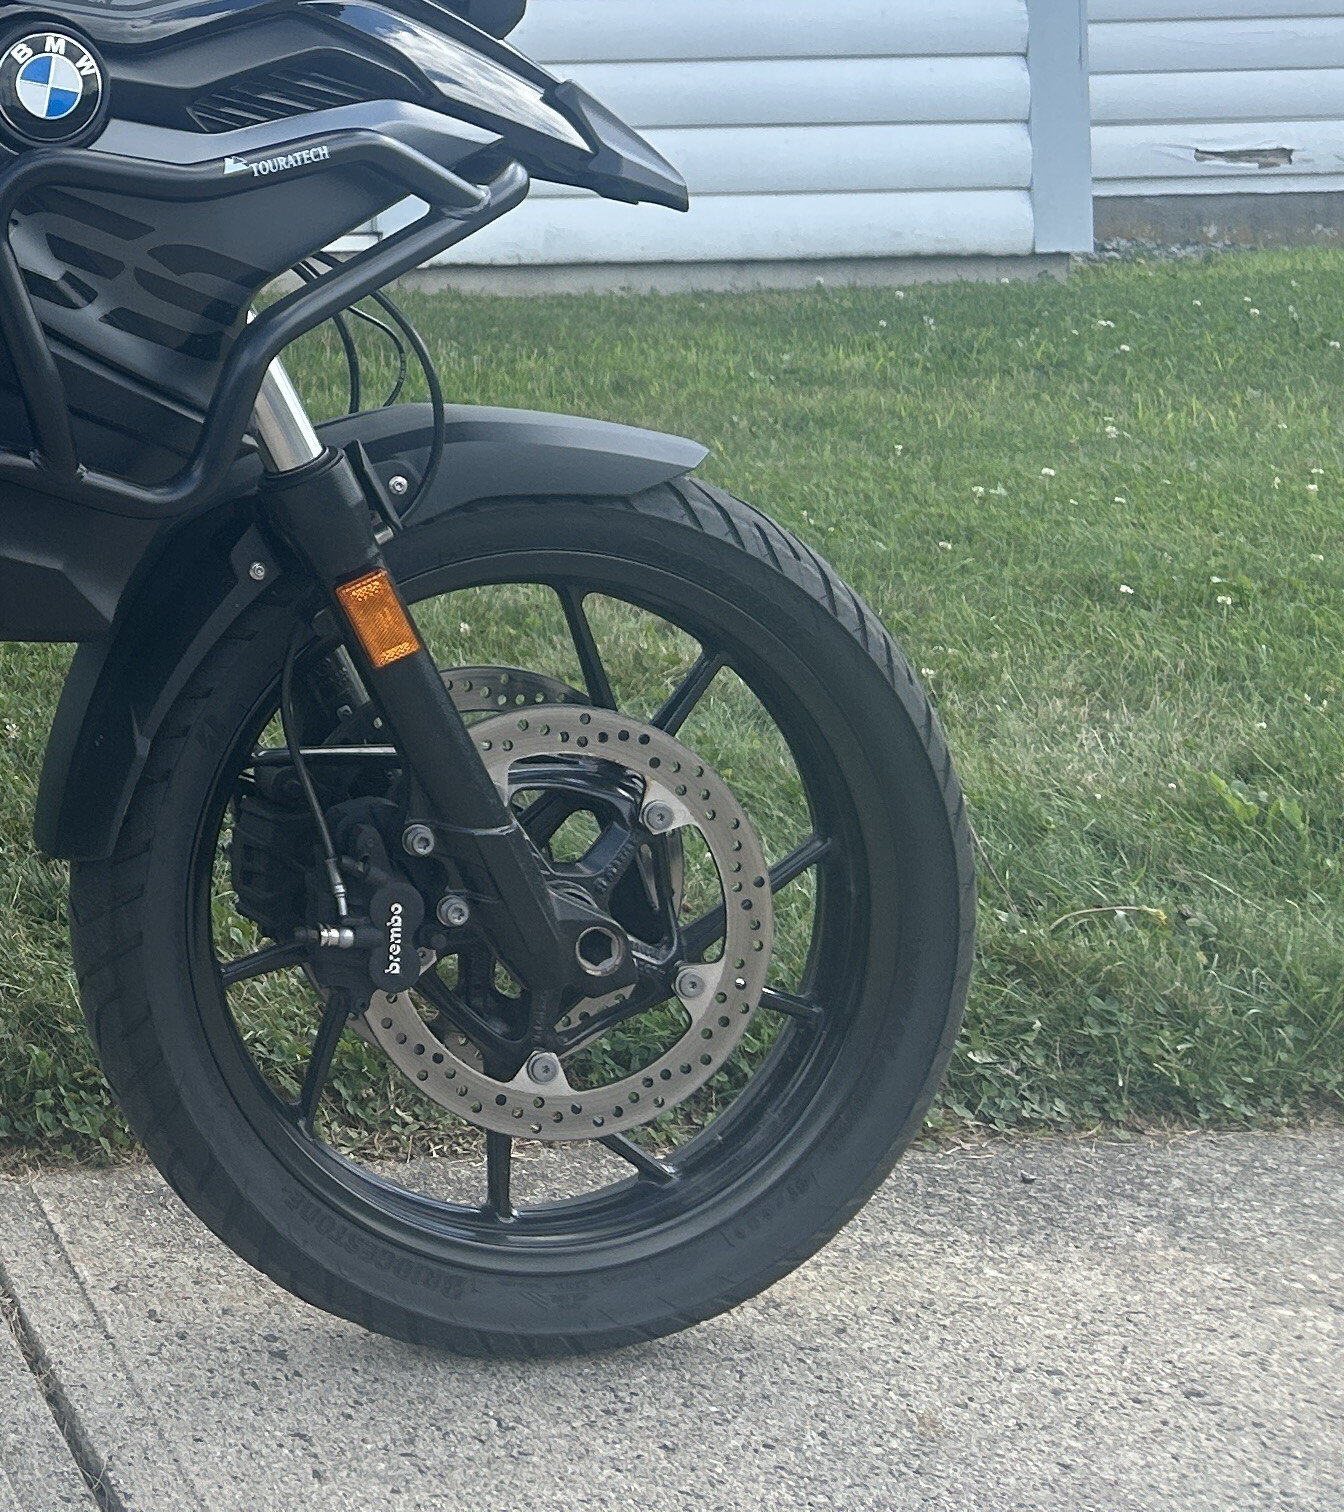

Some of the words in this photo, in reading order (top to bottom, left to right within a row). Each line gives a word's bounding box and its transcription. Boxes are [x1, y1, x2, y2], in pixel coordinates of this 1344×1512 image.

[11, 36, 96, 78] BMW
[250, 145, 330, 177] TOURATECH
[384, 902, 403, 974] brembo
